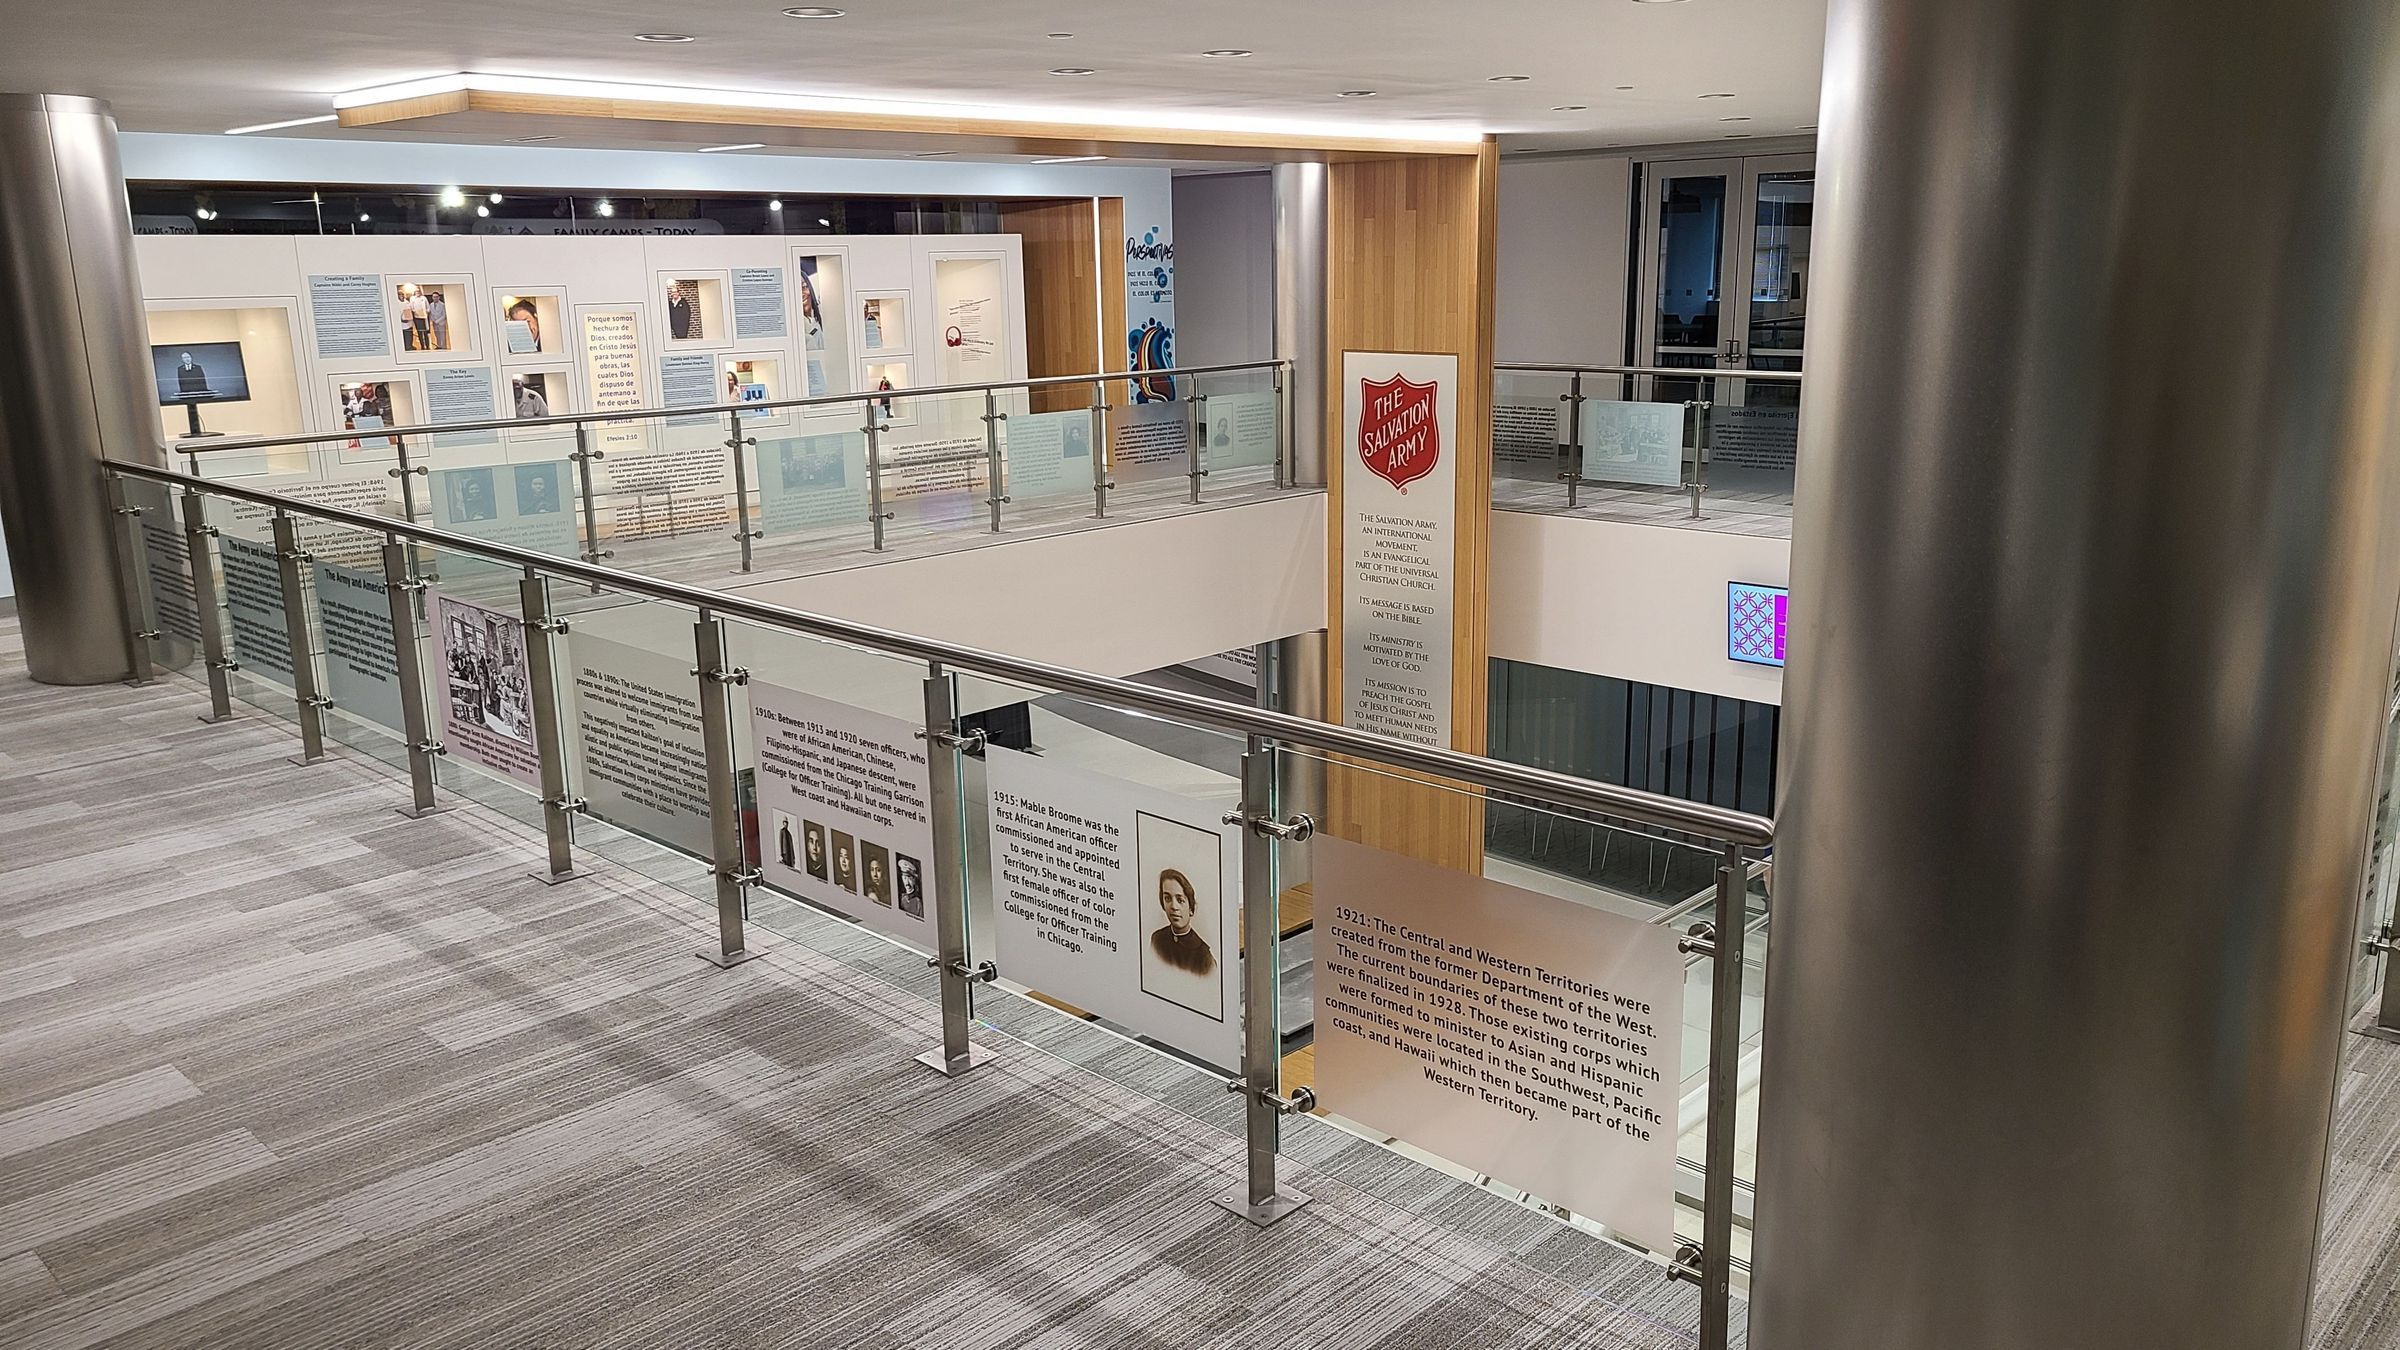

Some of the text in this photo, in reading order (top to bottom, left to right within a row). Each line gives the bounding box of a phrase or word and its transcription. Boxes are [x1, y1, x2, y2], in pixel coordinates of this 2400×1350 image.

[1364, 394, 1430, 457] SALVATION
[1374, 387, 1404, 421] THE
[1387, 426, 1428, 474] ARMY
[325, 568, 385, 595] The Army and America
[754, 705, 925, 765] 1910s: Between 1913 and 1920 seven officers, who
[782, 729, 895, 773] were of African American, Chinese,
[994, 790, 1118, 835] 1915: Mable Broome was the
[996, 806, 1117, 852] first African American officer
[995, 824, 1119, 870] commissioned and appointed
[1002, 855, 1114, 900] Territory. She was also the
[1004, 900, 1116, 953] College for Officer Training
[1331, 925, 1656, 1037] created from the former Department of the West.
[1336, 906, 1650, 1014] 1921: The Central and Western Territories were
[1327, 961, 1659, 1081] were finalized in 1928. Those existing corps which
[1336, 943, 1646, 1055] The current boundaries of these two territories
[1424, 1066, 1537, 1121] Western Territory.
